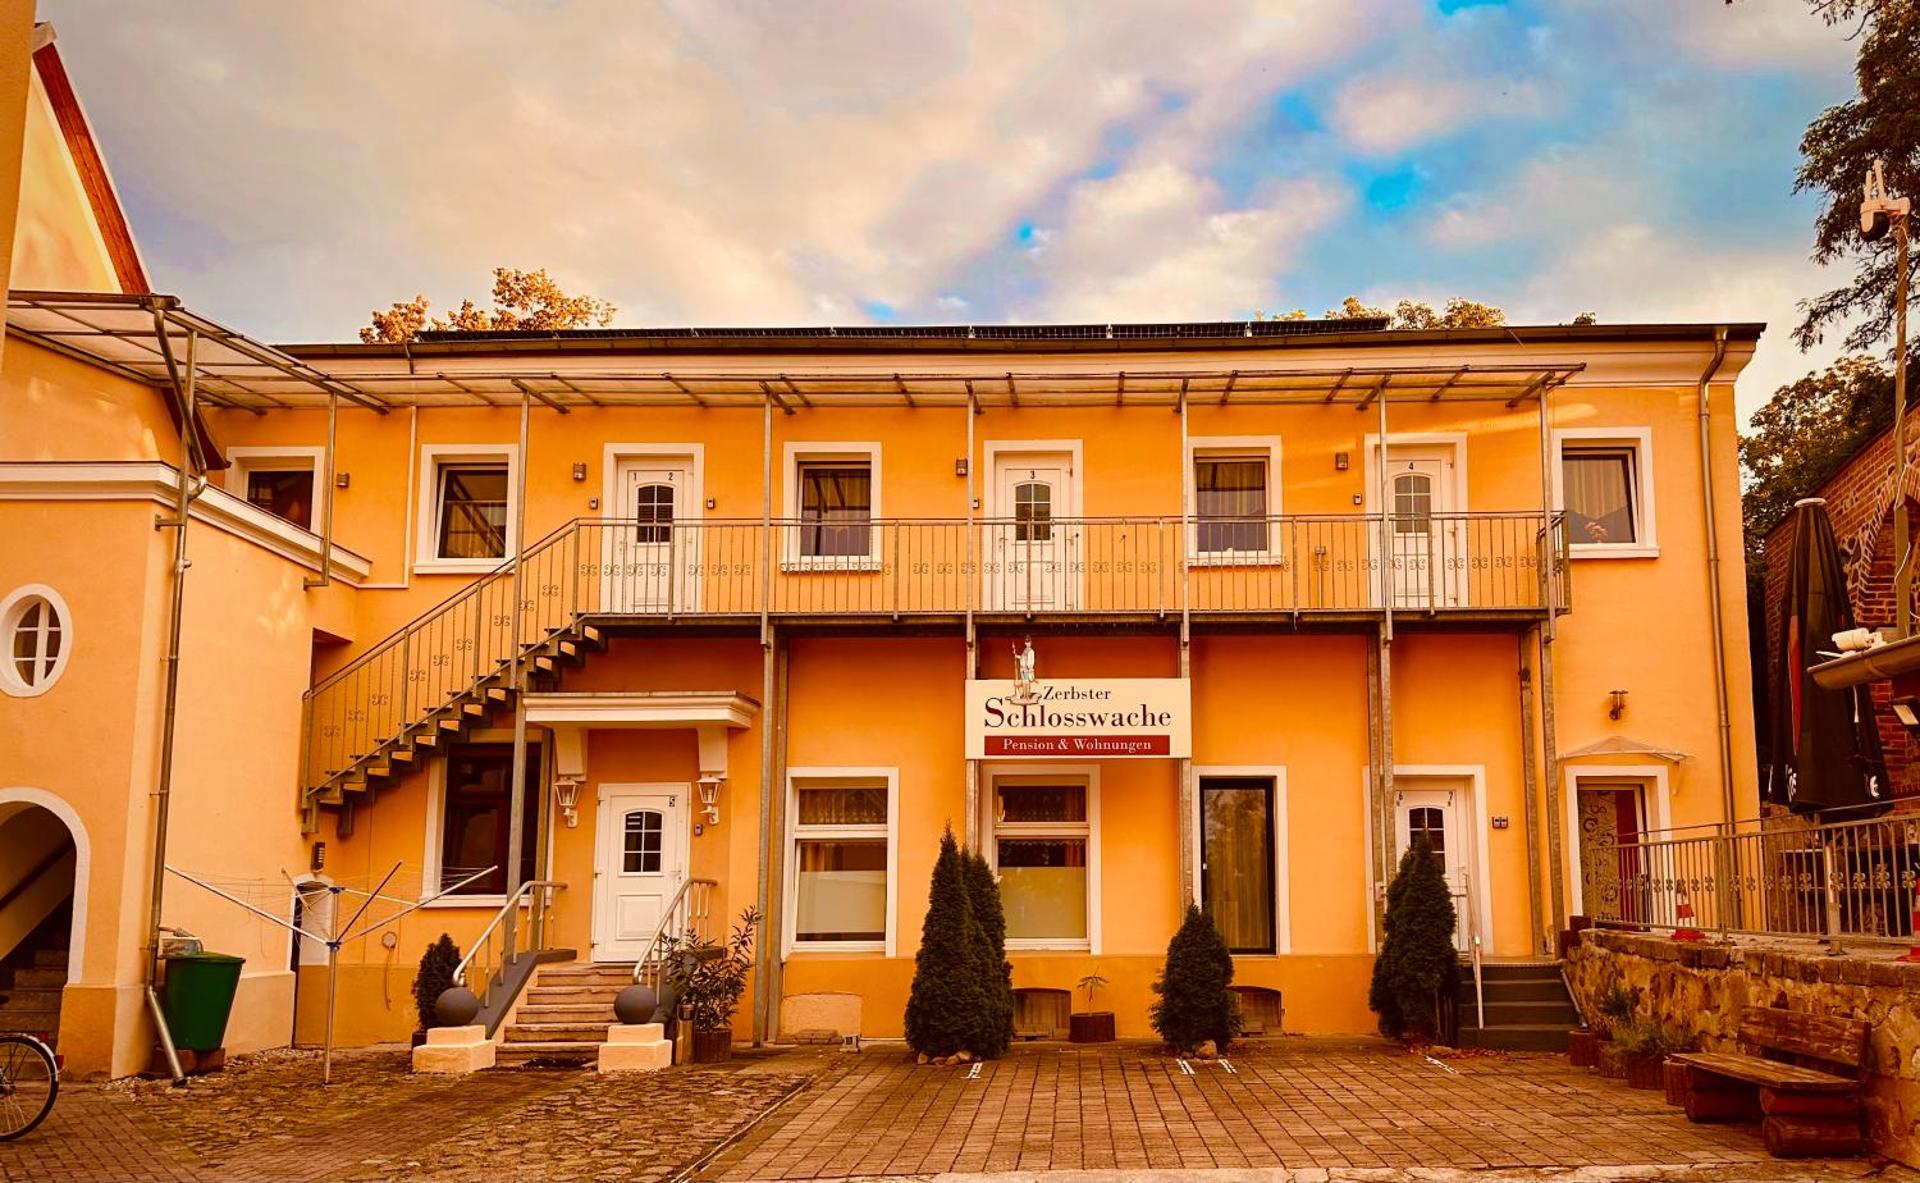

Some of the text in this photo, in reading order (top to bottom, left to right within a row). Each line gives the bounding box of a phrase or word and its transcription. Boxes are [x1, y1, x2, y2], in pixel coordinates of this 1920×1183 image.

[1408, 461, 1414, 471] 4
[668, 472, 674, 481] 2
[1029, 470, 1036, 480] 3
[1042, 685, 1112, 701] Zerbster
[984, 697, 1172, 728] Schlosswache
[1003, 738, 1152, 753] Pension & Wohnungen
